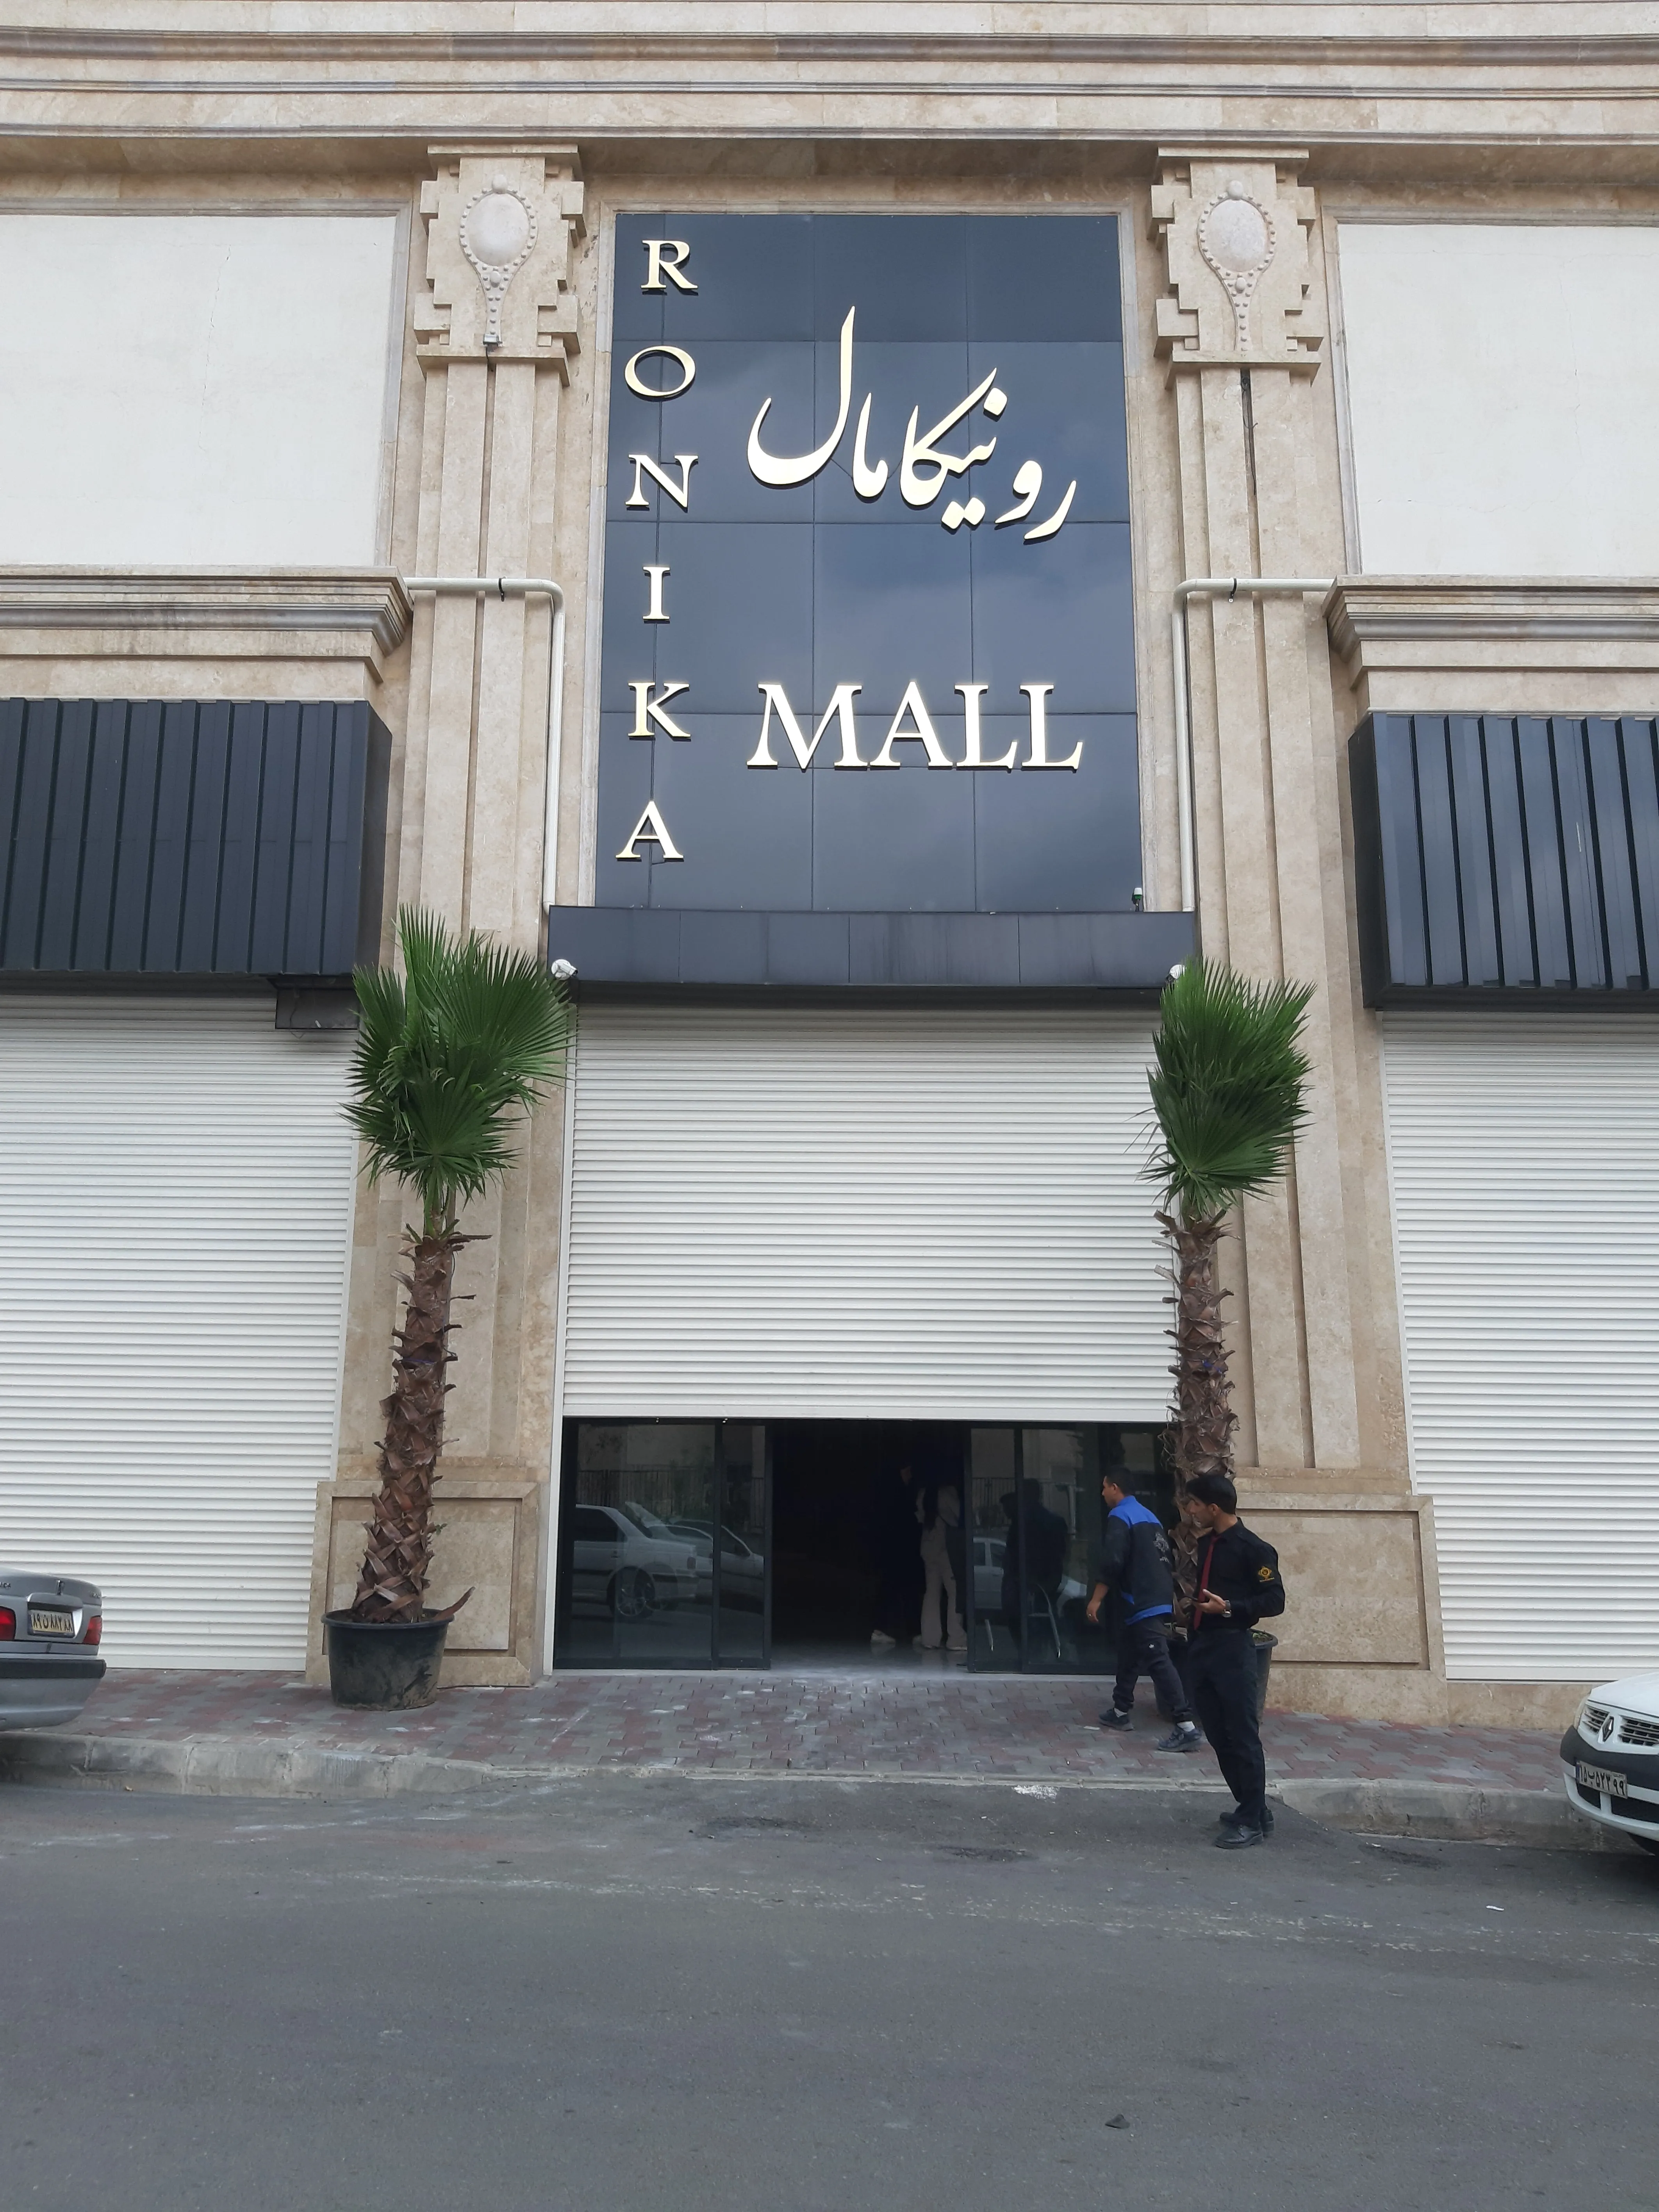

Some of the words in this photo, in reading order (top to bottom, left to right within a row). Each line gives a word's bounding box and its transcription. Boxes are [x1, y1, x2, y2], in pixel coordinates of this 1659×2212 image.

[747, 305, 888, 498] مال
[615, 240, 699, 859] RONIKA
[746, 680, 1083, 772] MALL
